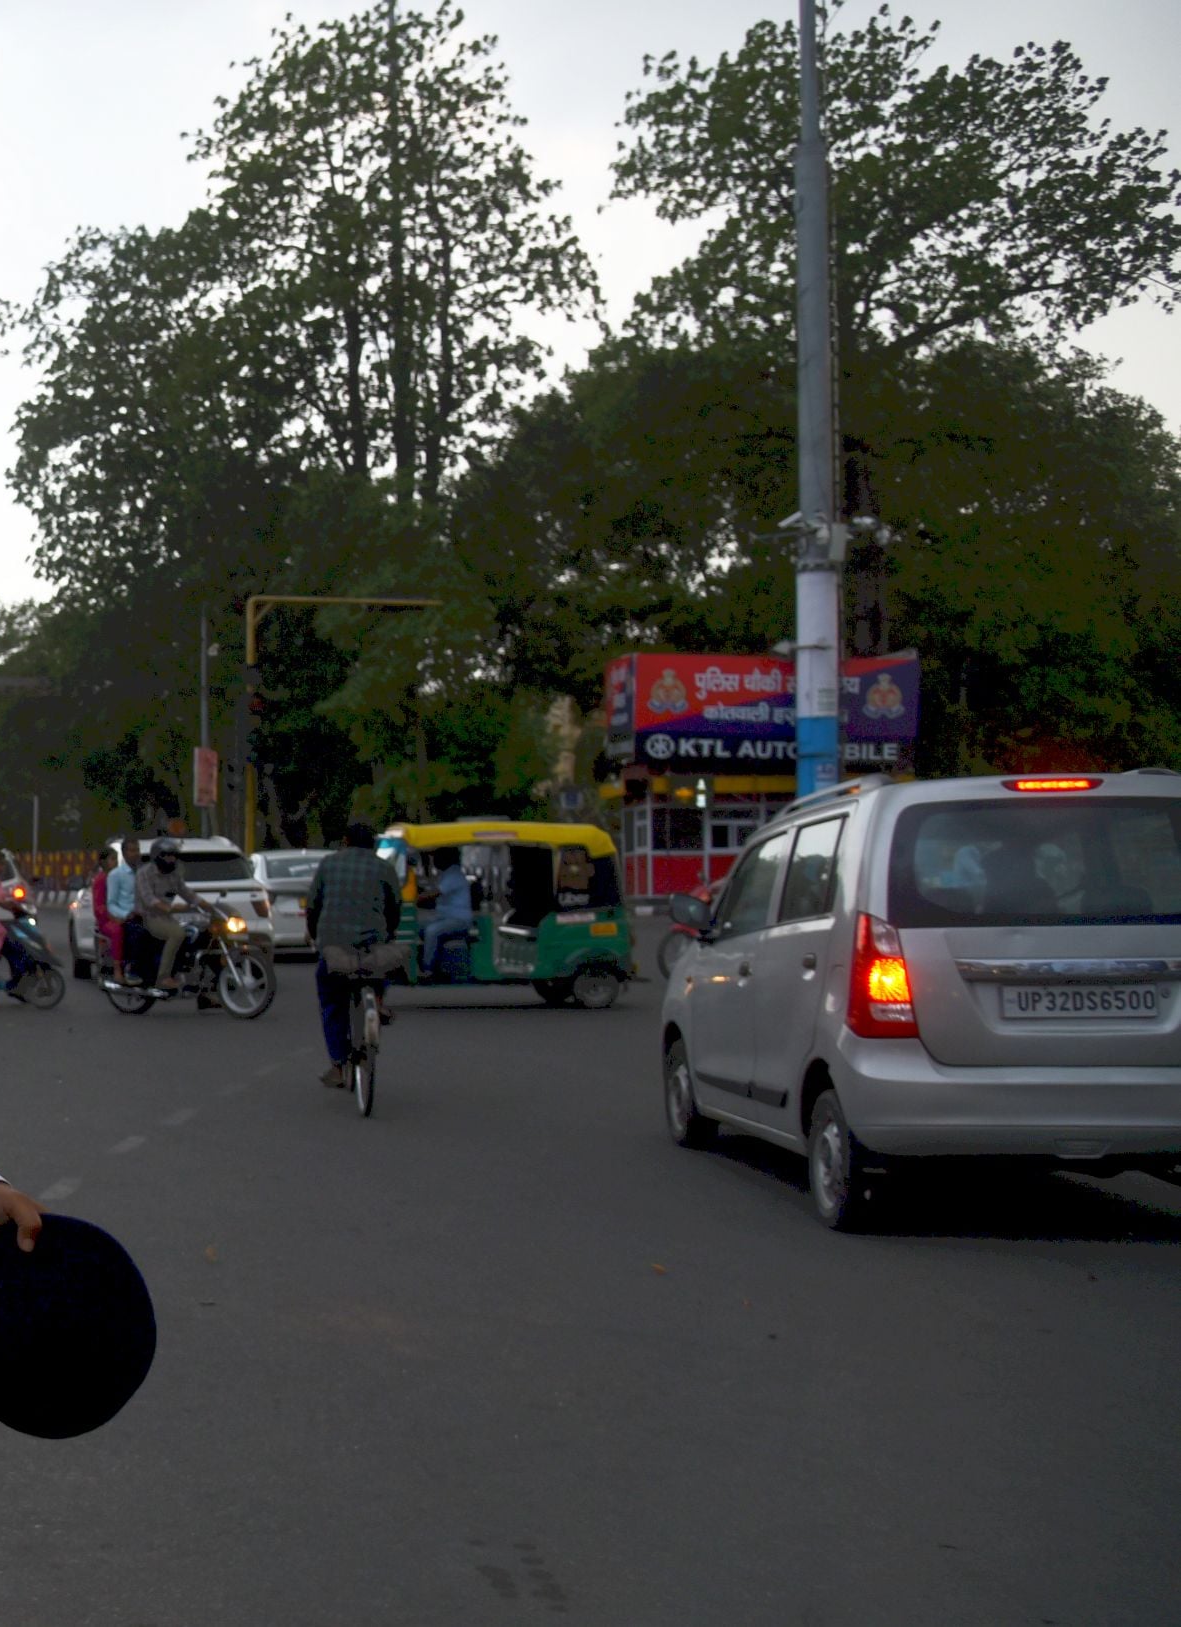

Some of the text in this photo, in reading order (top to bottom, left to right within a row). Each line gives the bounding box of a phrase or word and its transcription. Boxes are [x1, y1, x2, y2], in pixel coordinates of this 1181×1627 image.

[694, 667, 739, 699] पुलिस
[743, 668, 782, 691] चौकी
[703, 702, 770, 722] कोतवाली
[678, 737, 898, 761] KTL AUTOBILE
[1018, 990, 1155, 1012] UP32DS6500
